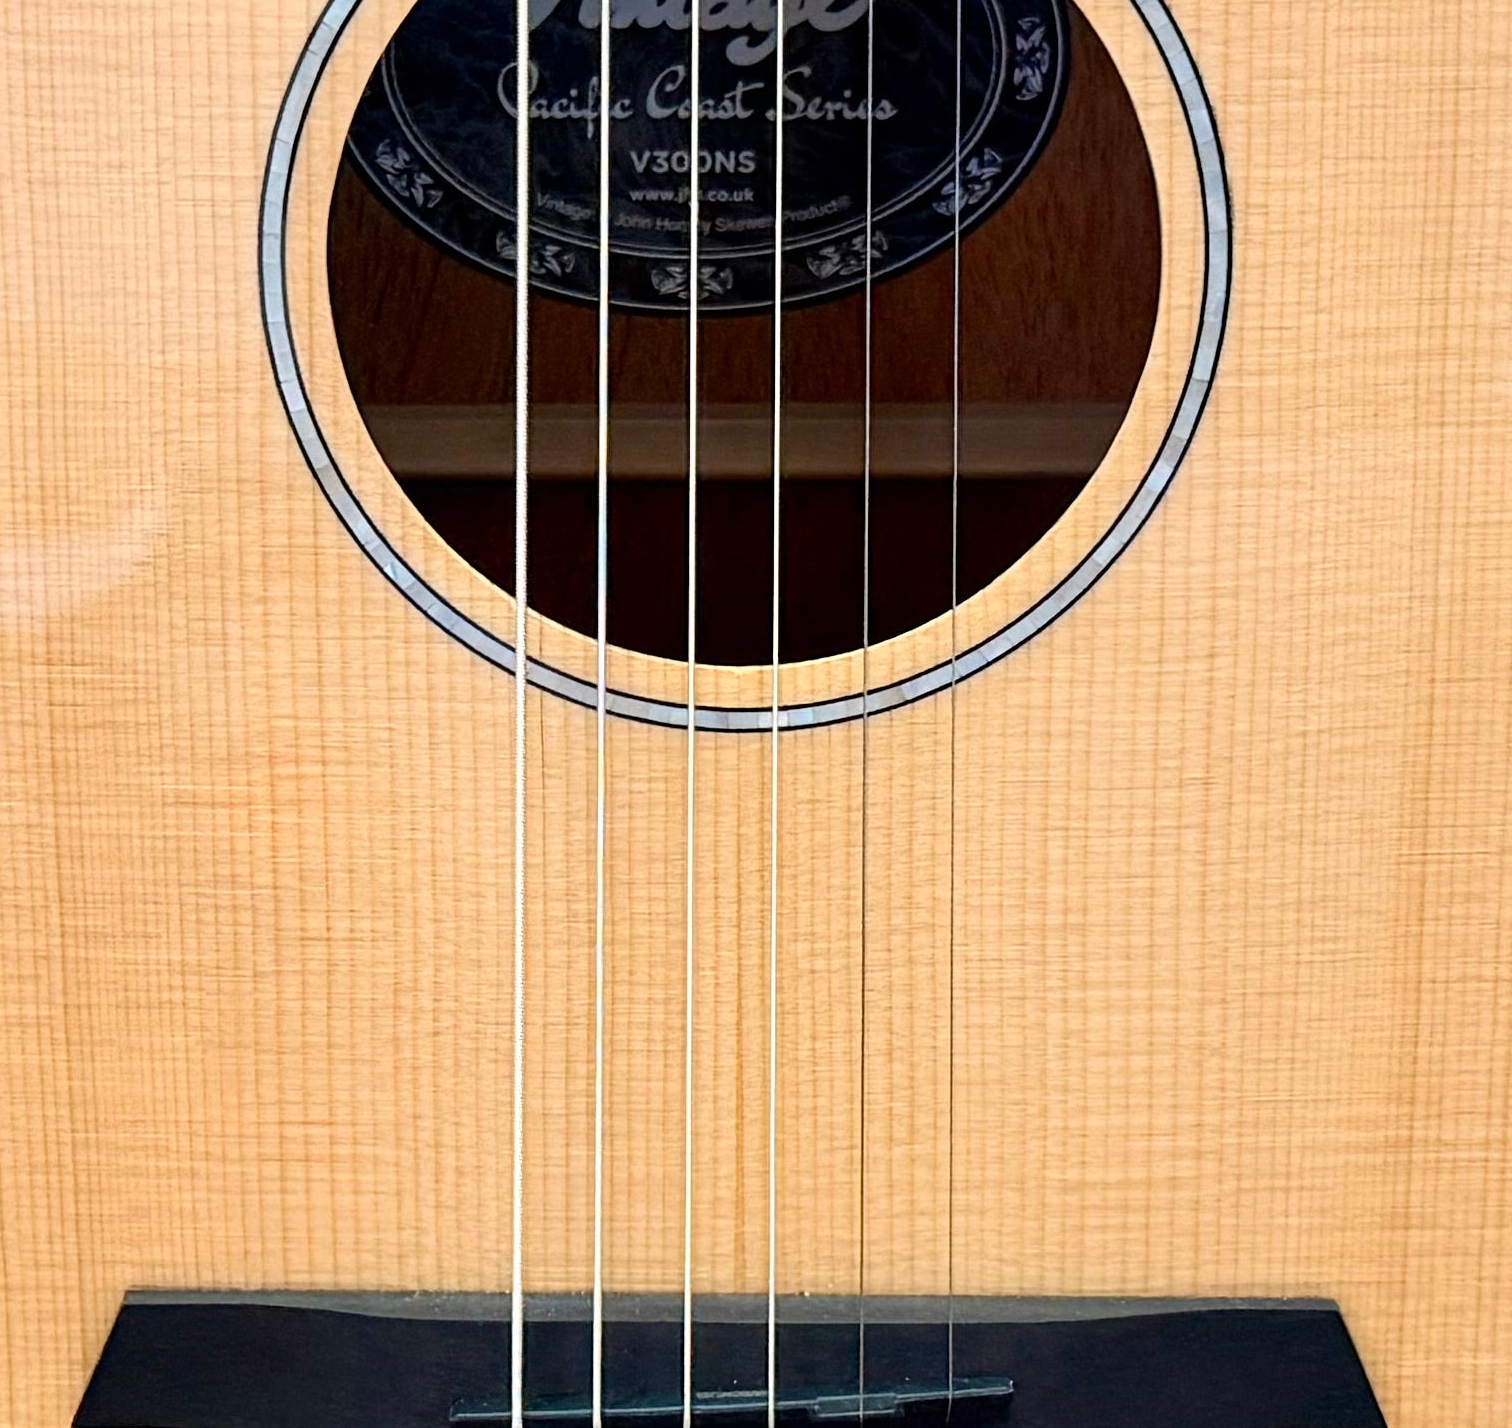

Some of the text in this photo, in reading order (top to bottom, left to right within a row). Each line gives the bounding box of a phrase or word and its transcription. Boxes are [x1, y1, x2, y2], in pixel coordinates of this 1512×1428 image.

[497, 61, 899, 138] Pacifc Coast Series
[629, 150, 757, 173] V300NS
